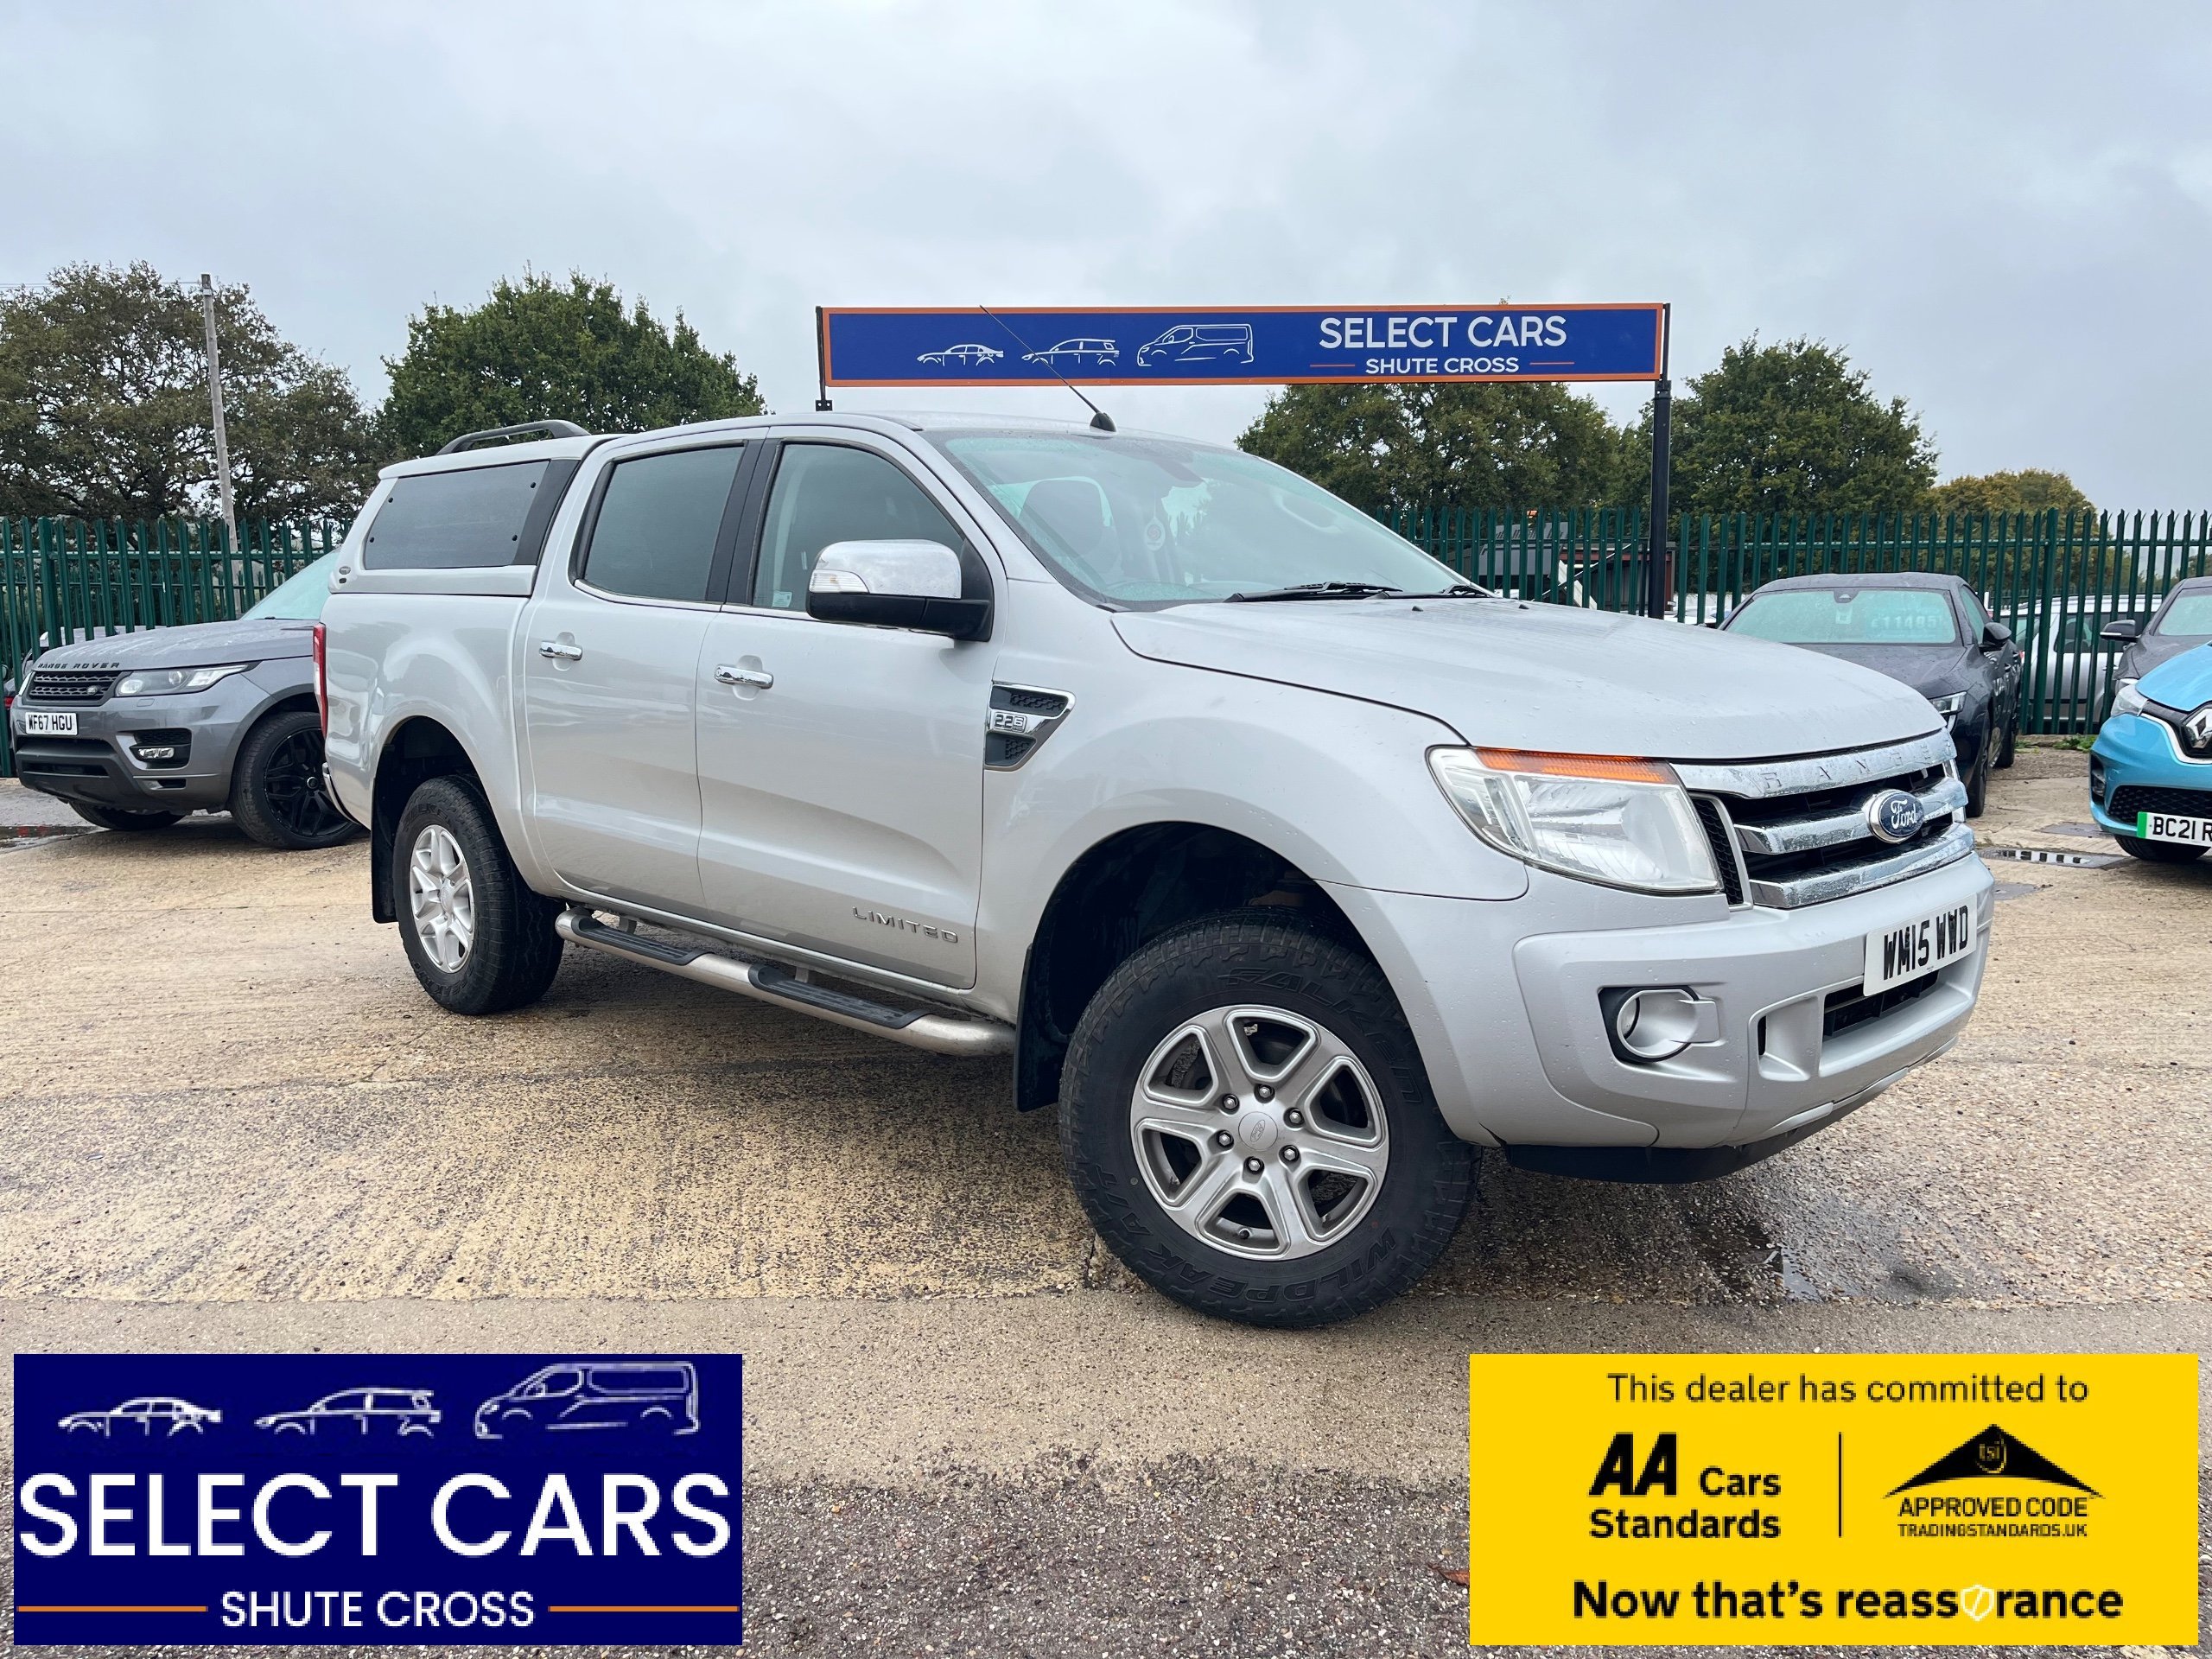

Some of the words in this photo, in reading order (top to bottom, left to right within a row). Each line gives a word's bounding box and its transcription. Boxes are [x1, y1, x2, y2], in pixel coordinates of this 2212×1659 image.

[1319, 316, 1458, 349] SELECT
[1467, 315, 1567, 347] CARS
[1365, 358, 1439, 374] SHUTE
[1444, 357, 1519, 373] CROSS
[28, 715, 49, 731] WF67
[52, 715, 73, 731] HGU
[1890, 798, 1918, 830] Ford
[2152, 816, 2196, 840] BC21
[852, 906, 959, 944] LIMITED
[1883, 918, 1930, 981] WM15
[1217, 967, 1424, 1103] FALKEN
[1142, 1225, 1397, 1304] WILDPEAK
